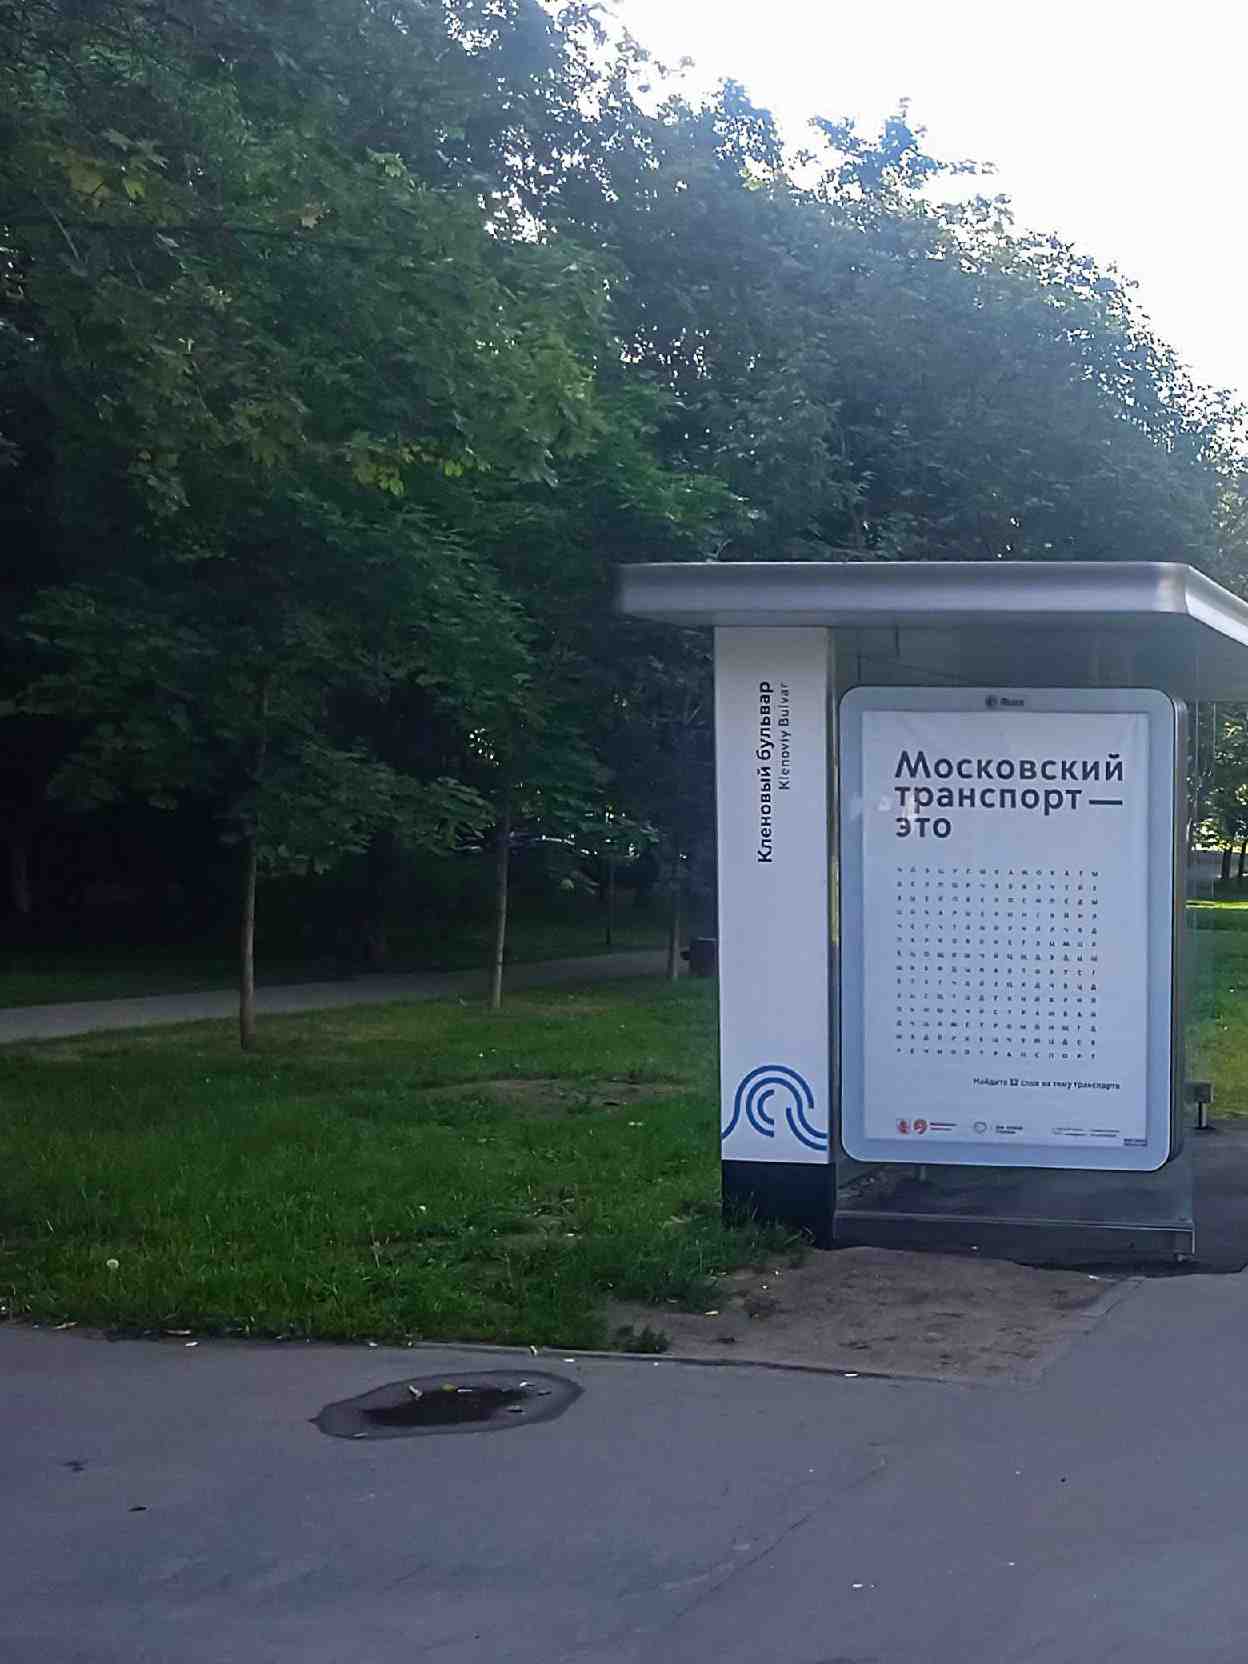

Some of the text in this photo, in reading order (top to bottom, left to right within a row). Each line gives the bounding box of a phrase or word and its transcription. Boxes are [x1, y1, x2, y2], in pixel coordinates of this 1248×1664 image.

[778, 682, 792, 790] Klenoviy Bulvar
[756, 681, 774, 864] Кленовый бульвар
[894, 750, 1124, 782] Московский
[894, 786, 1083, 816] транспорт
[895, 817, 952, 838] это
